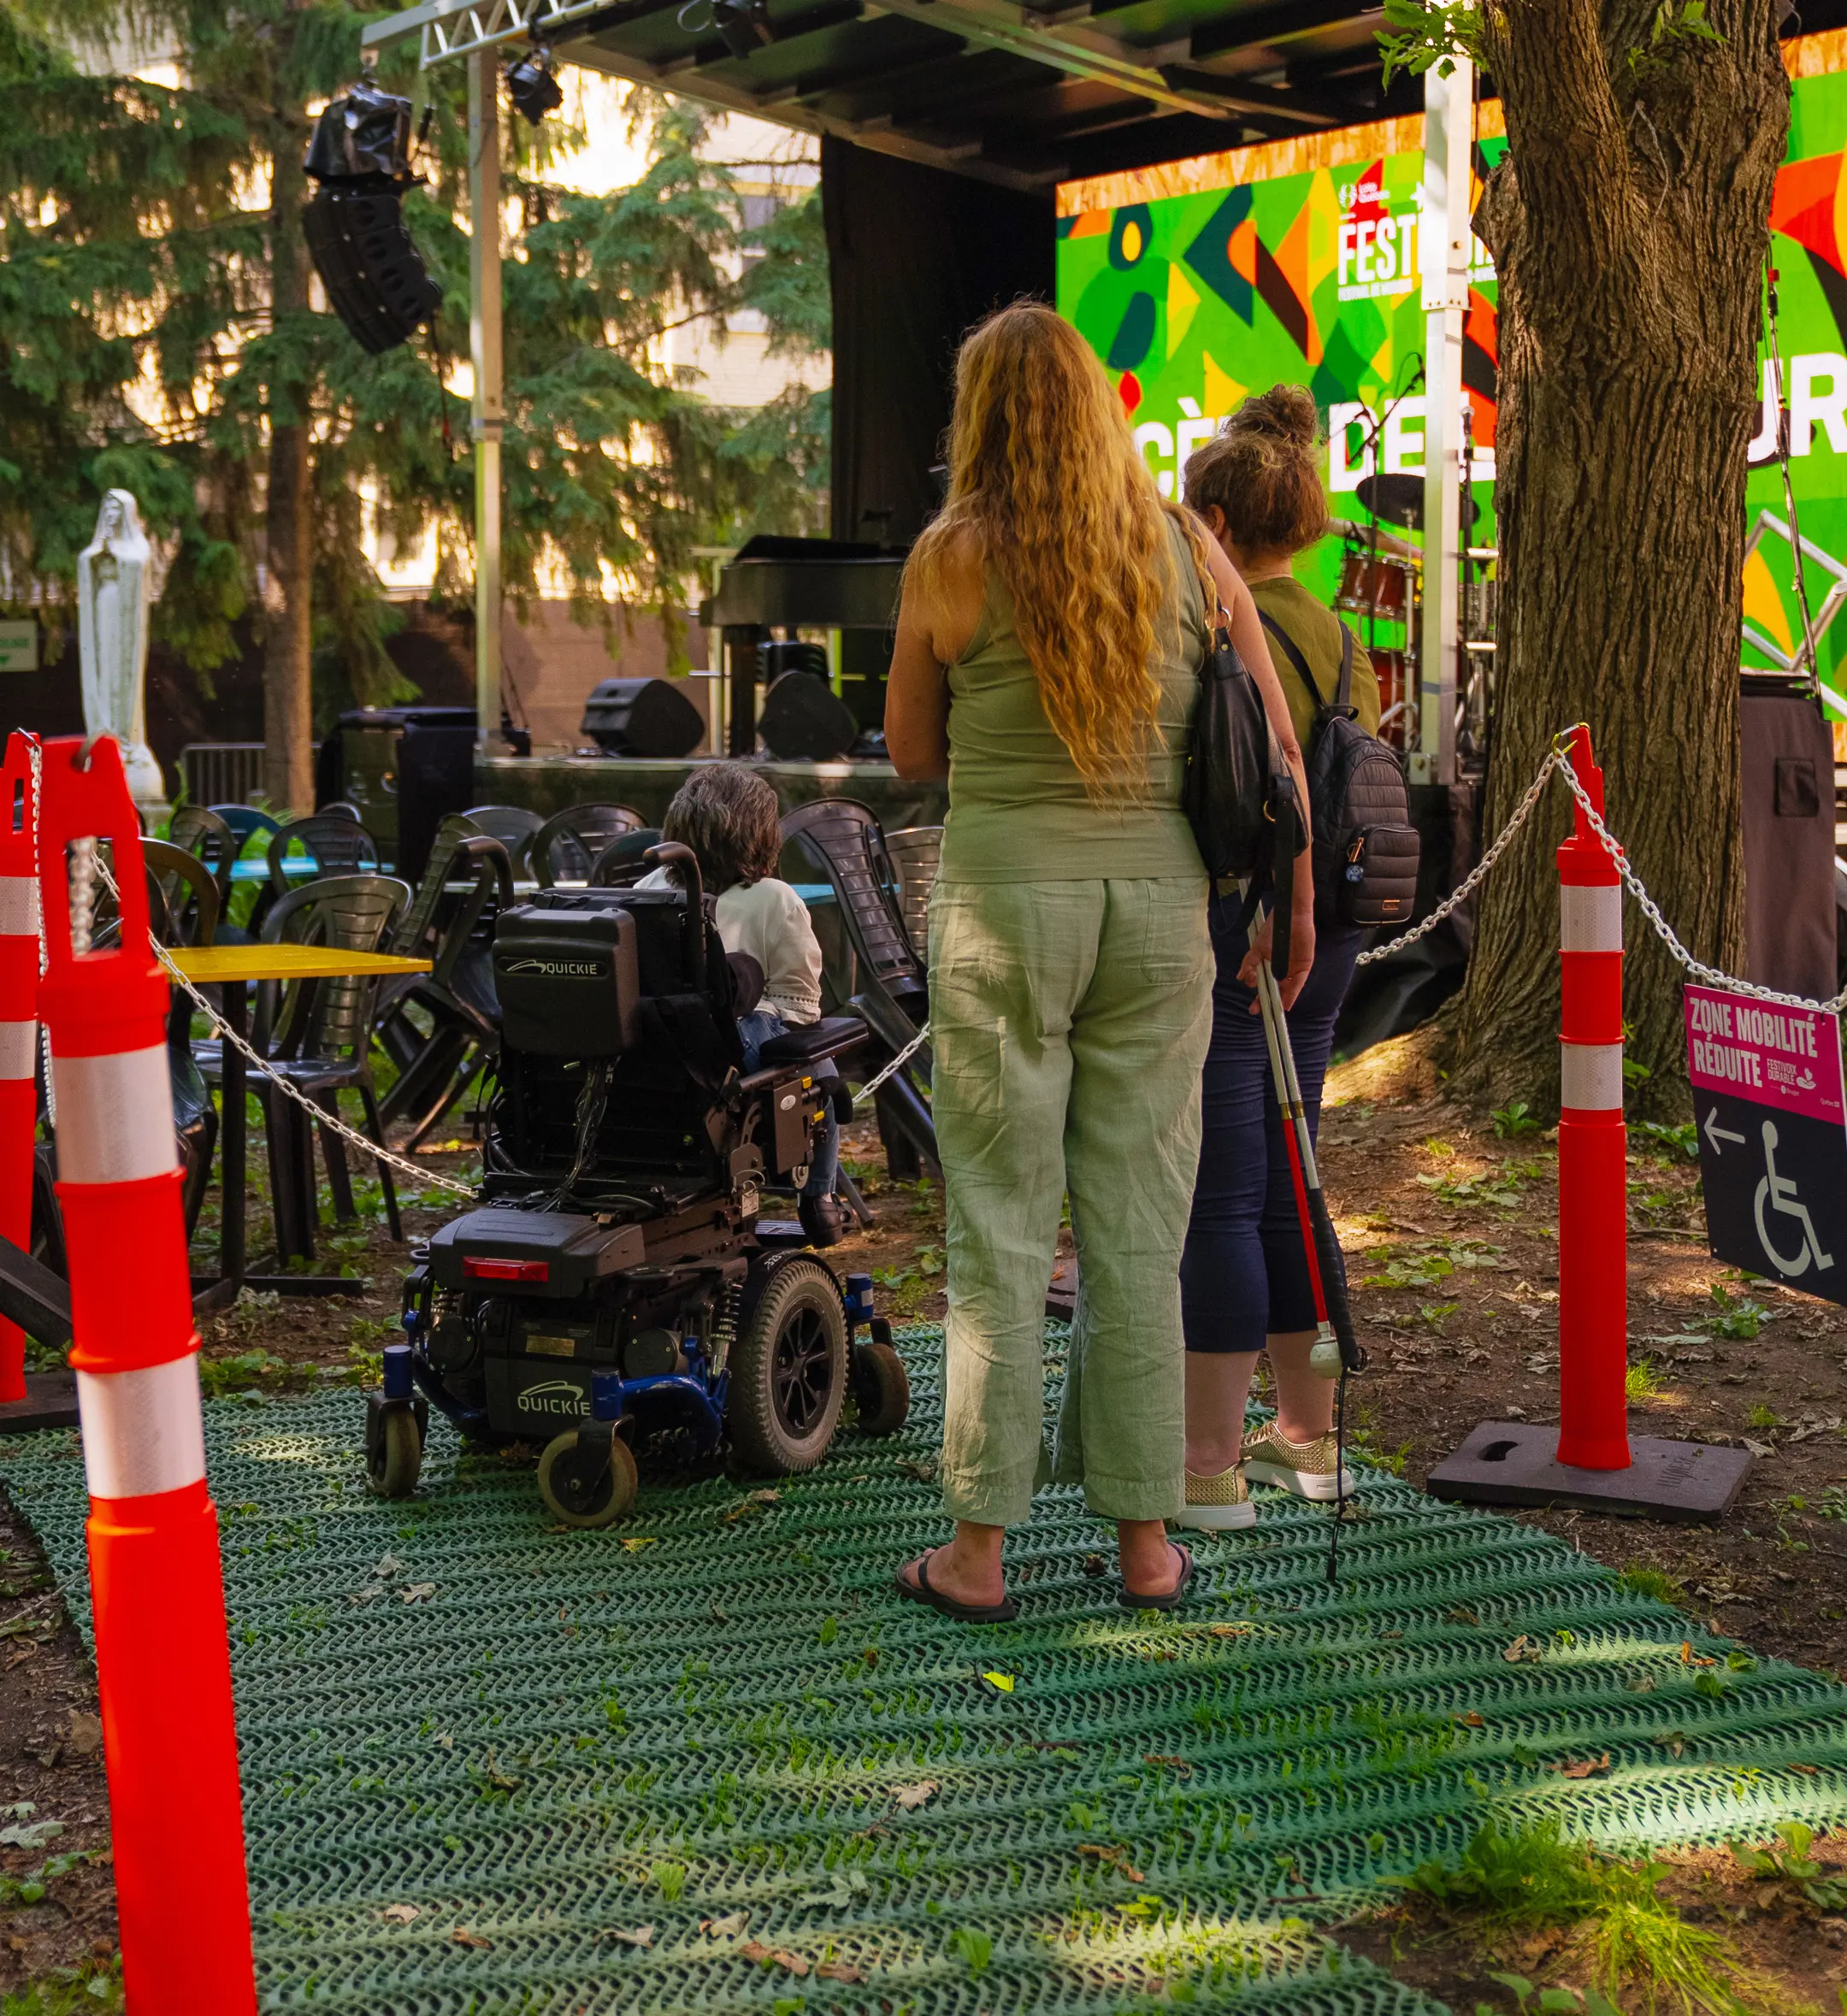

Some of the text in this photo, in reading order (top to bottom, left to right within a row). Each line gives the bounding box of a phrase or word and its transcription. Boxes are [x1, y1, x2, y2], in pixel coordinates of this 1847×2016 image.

[1134, 397, 1231, 504] CÈ
[546, 963, 597, 975] QUICKIE
[1690, 997, 1818, 1058] ZONE MOBILITÉ
[1693, 1034, 1762, 1088] RÉDUITE
[1767, 1058, 1797, 1076] FESTIVOIX
[1768, 1069, 1795, 1086] DURABLE
[517, 1395, 591, 1416] QUICKIE
